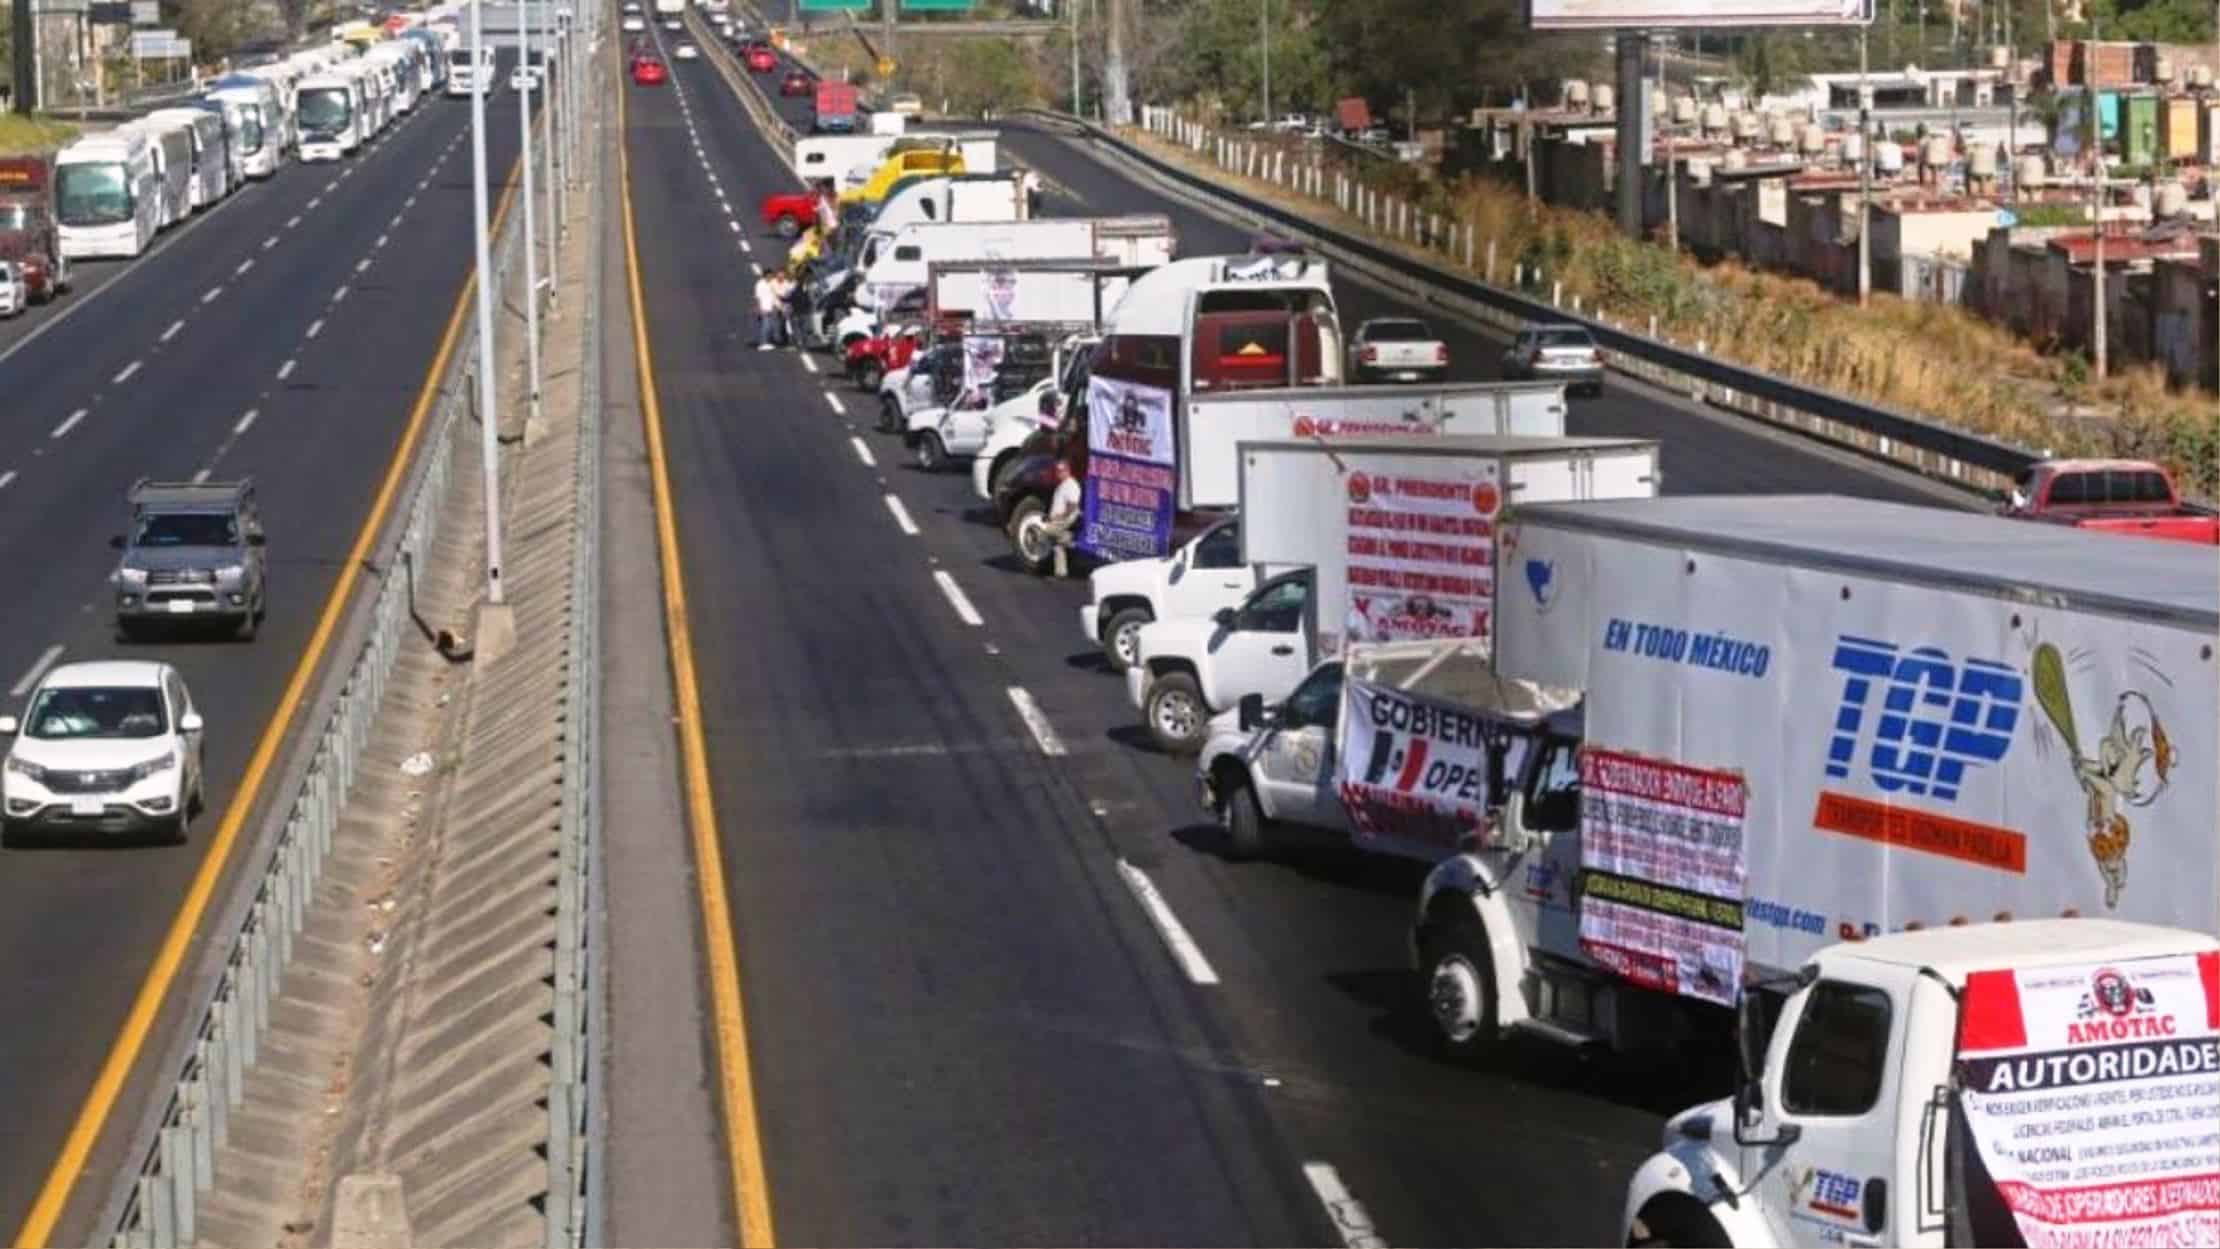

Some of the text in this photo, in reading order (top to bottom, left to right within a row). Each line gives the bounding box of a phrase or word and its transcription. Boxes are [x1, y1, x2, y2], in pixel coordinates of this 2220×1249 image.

[1604, 617, 1770, 678] EN TODO MÉXICO
[1371, 694, 1511, 756] GOBIERNO
[1825, 635, 2023, 801] TGP
[1424, 759, 1483, 802] OPE
[2067, 1015, 2177, 1045] AMOTAC
[2017, 1144, 2073, 1164] NACIONAL
[1814, 1169, 1861, 1206] TGP
